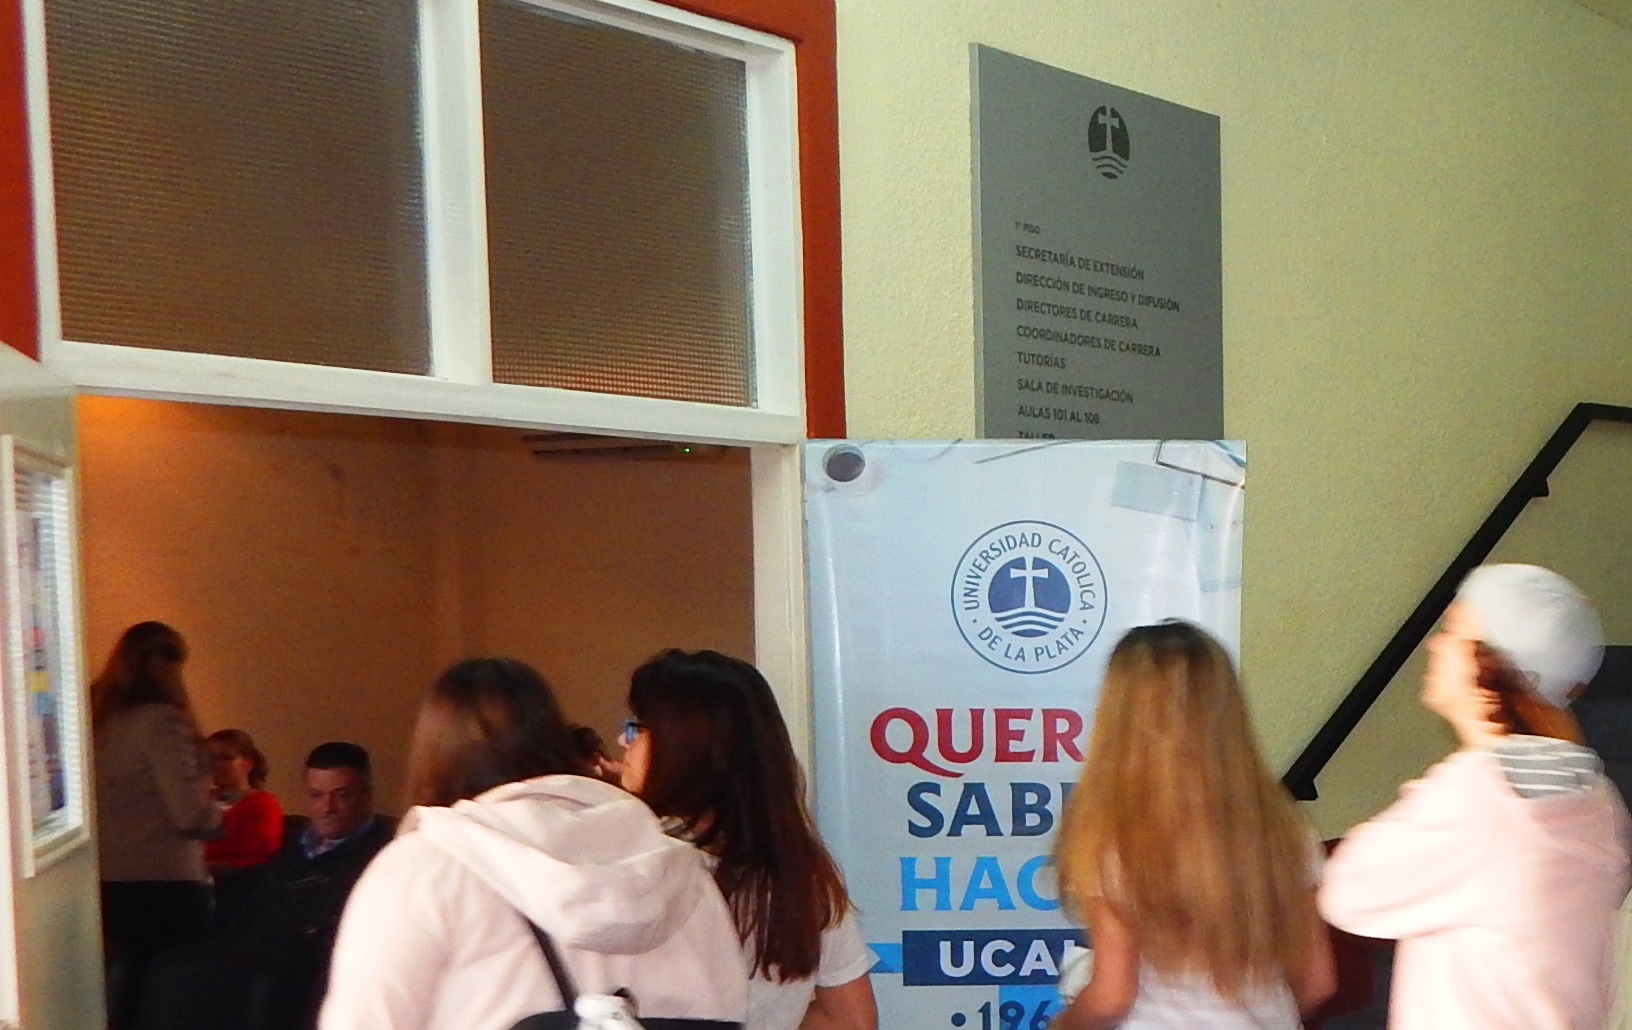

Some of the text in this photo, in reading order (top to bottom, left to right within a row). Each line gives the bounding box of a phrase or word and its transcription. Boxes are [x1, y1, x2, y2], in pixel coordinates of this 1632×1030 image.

[1015, 244, 1145, 280] SECRETARÍA DE EXTENSIÓN
[1015, 271, 1181, 312] DIRECCIÓN DE INGRESO Y DIFUSIÓN
[1016, 297, 1139, 329] DIRECTORES DE CARRERA
[1016, 324, 1162, 358] COORDINADORES DE CARRERA
[1017, 351, 1066, 370] TUTORÍAS
[1017, 377, 1134, 404] SALA DE INVESTIGACIÓN
[1018, 404, 1051, 420] AULAS
[1053, 407, 1068, 422] 101
[1069, 412, 1083, 423] AL
[963, 532, 1096, 611] UNIVERSIDAD CATOLICA
[977, 626, 1085, 662] DE LA PLATA
[869, 706, 1087, 778] QUER
[906, 780, 1081, 839] SAB
[899, 854, 1062, 911] HAC
[938, 938, 1076, 978] UCA
